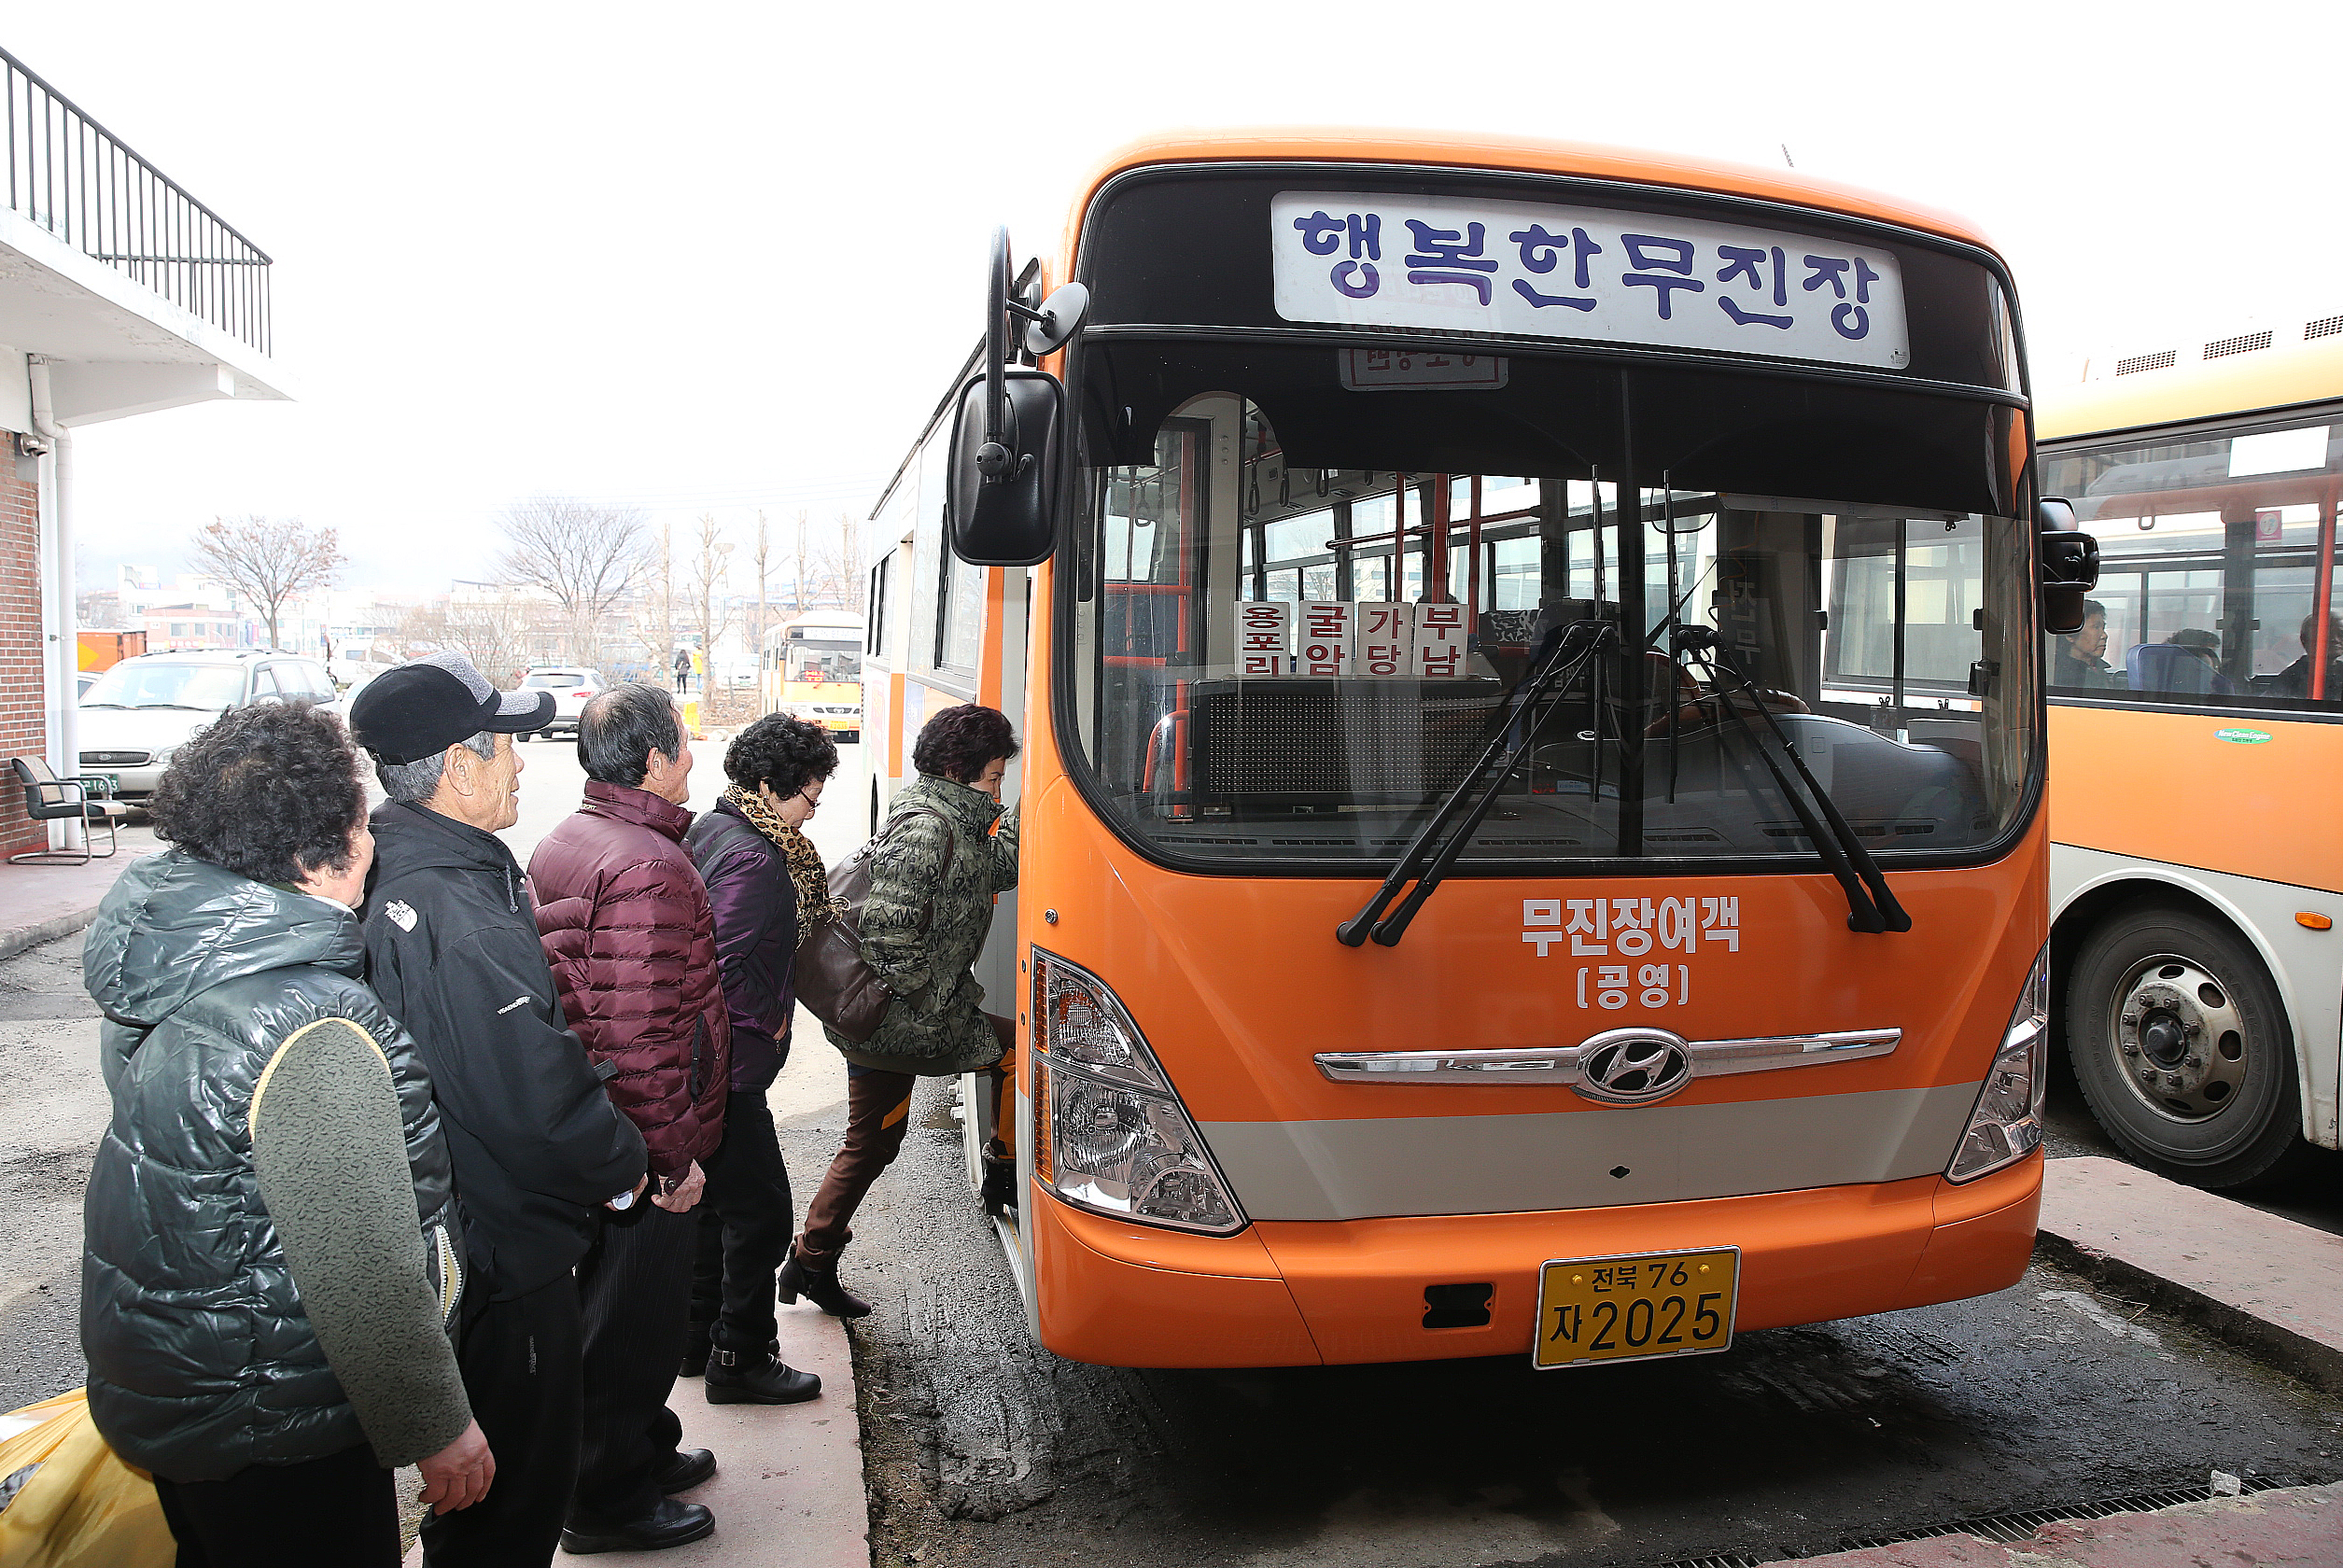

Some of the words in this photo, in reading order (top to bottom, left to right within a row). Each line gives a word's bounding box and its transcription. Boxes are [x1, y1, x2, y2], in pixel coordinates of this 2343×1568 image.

[1242, 607, 1284, 678] 용포리
[1306, 605, 1347, 678] 굴암
[1368, 608, 1403, 677] 가당
[1422, 608, 1463, 678] 부남
[1522, 896, 1739, 958] 무진장여객
[1592, 1265, 1637, 1293] 전북
[1648, 1261, 1689, 1289] 76
